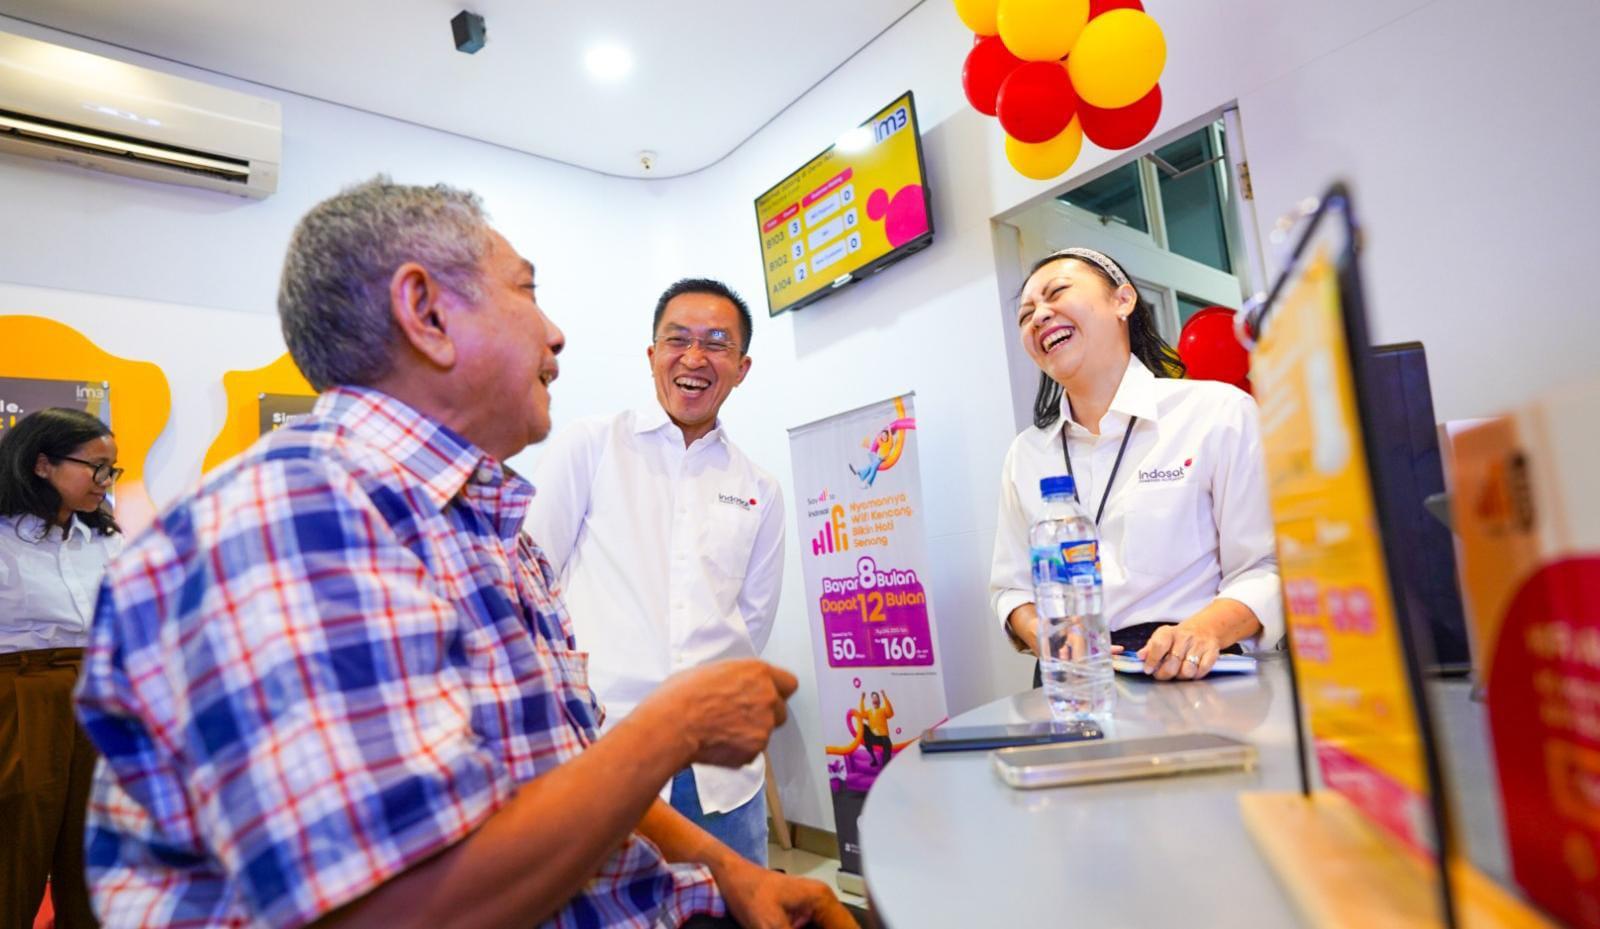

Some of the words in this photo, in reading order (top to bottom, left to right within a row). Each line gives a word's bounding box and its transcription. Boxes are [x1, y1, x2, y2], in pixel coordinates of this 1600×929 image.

[843, 190, 851, 201] 0
[847, 213, 854, 225] 0
[792, 221, 798, 233] 3
[850, 237, 858, 248] 0
[796, 245, 802, 257] 3
[799, 268, 805, 280] 2
[1138, 466, 1185, 479] Indosat
[850, 493, 907, 512] Nyamannya
[871, 506, 913, 520] Kencang
[854, 536, 888, 548] Senang
[823, 578, 859, 595] Bayar
[858, 557, 877, 589] 8
[876, 571, 916, 587] Bulan
[821, 597, 858, 614] Dapat
[857, 591, 887, 623] 12
[885, 591, 926, 607] Bulan
[832, 638, 856, 660] 50
